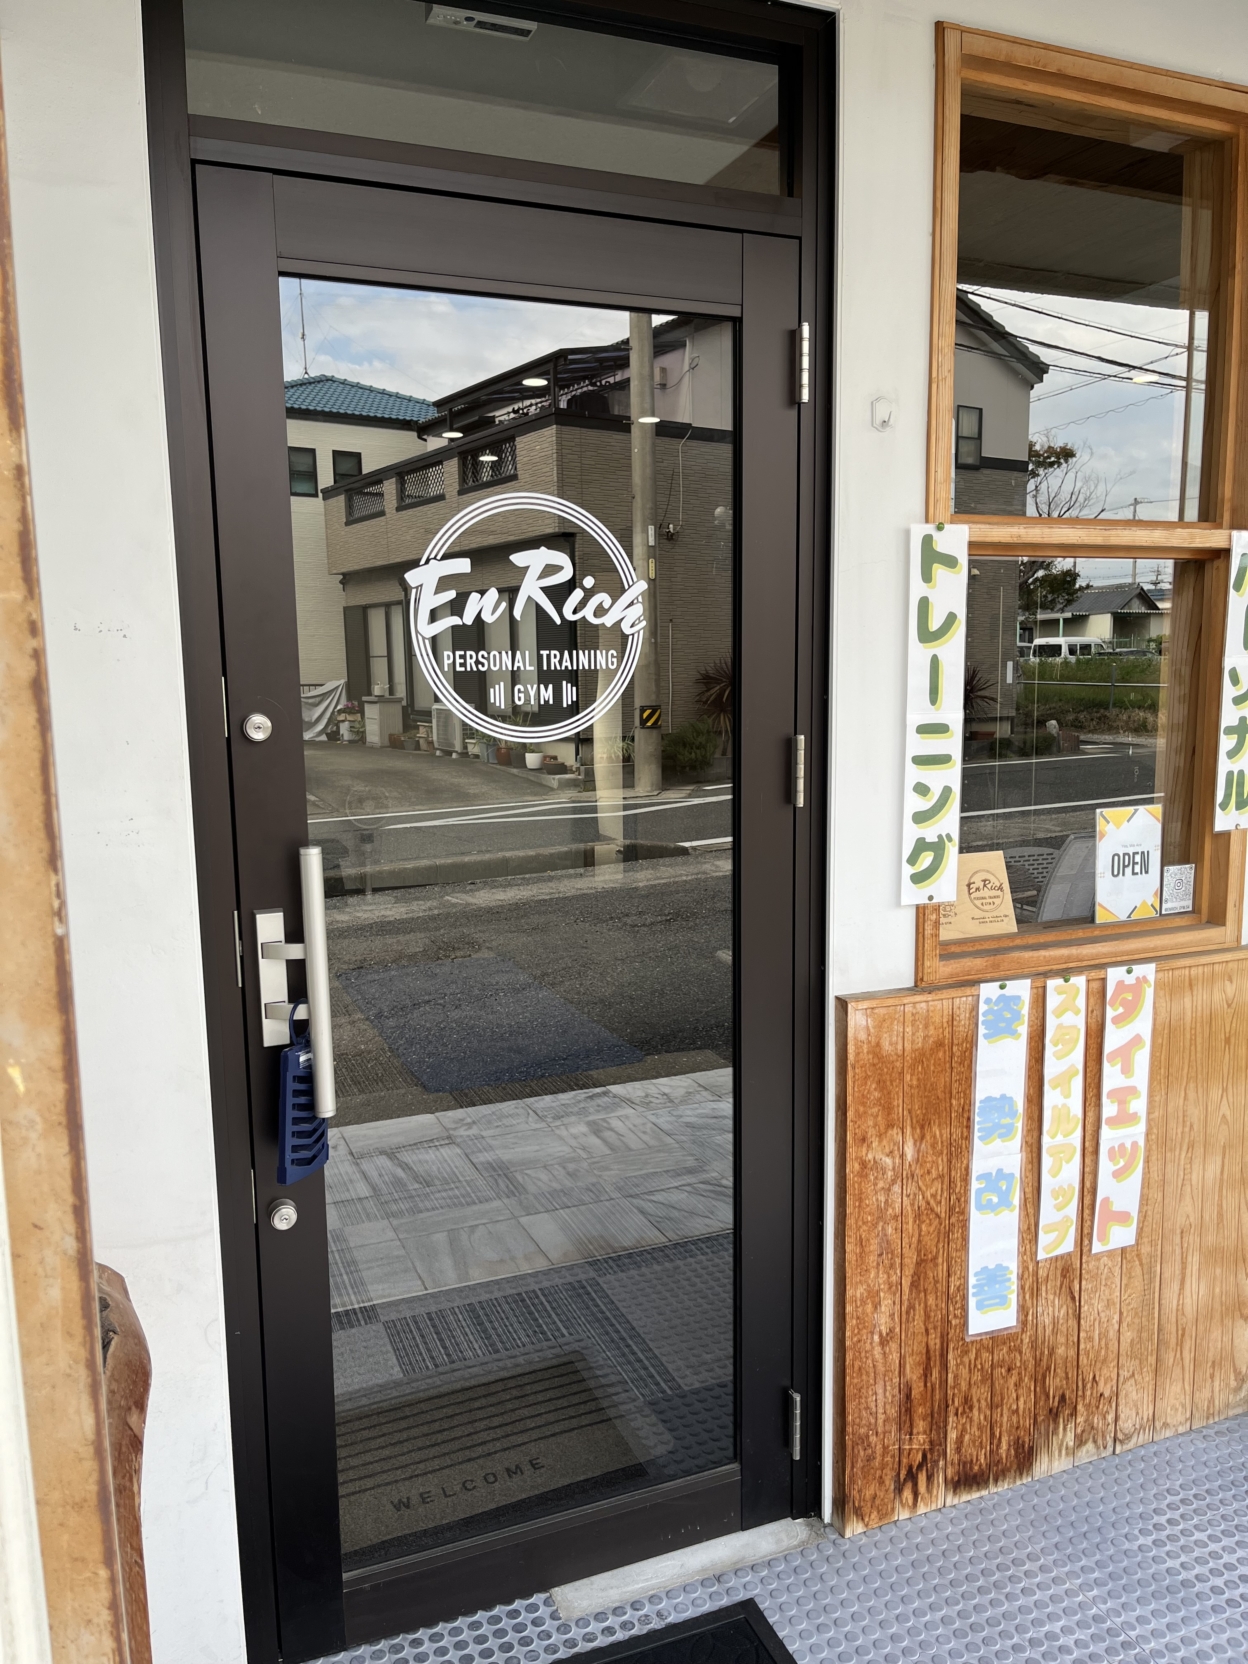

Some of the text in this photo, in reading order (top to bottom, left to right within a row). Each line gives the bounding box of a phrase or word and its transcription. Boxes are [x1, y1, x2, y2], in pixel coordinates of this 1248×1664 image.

[443, 649, 618, 672] PERSONAL TRAINING
[513, 683, 554, 706] GYM
[906, 533, 962, 891] トレーニング
[1111, 850, 1150, 878] OPEN
[971, 993, 1025, 1315] 姿勢改善
[1041, 982, 1081, 1255] スタイルアップ
[1096, 975, 1152, 1247] ダイエット
[390, 1457, 545, 1513] WELCOME
